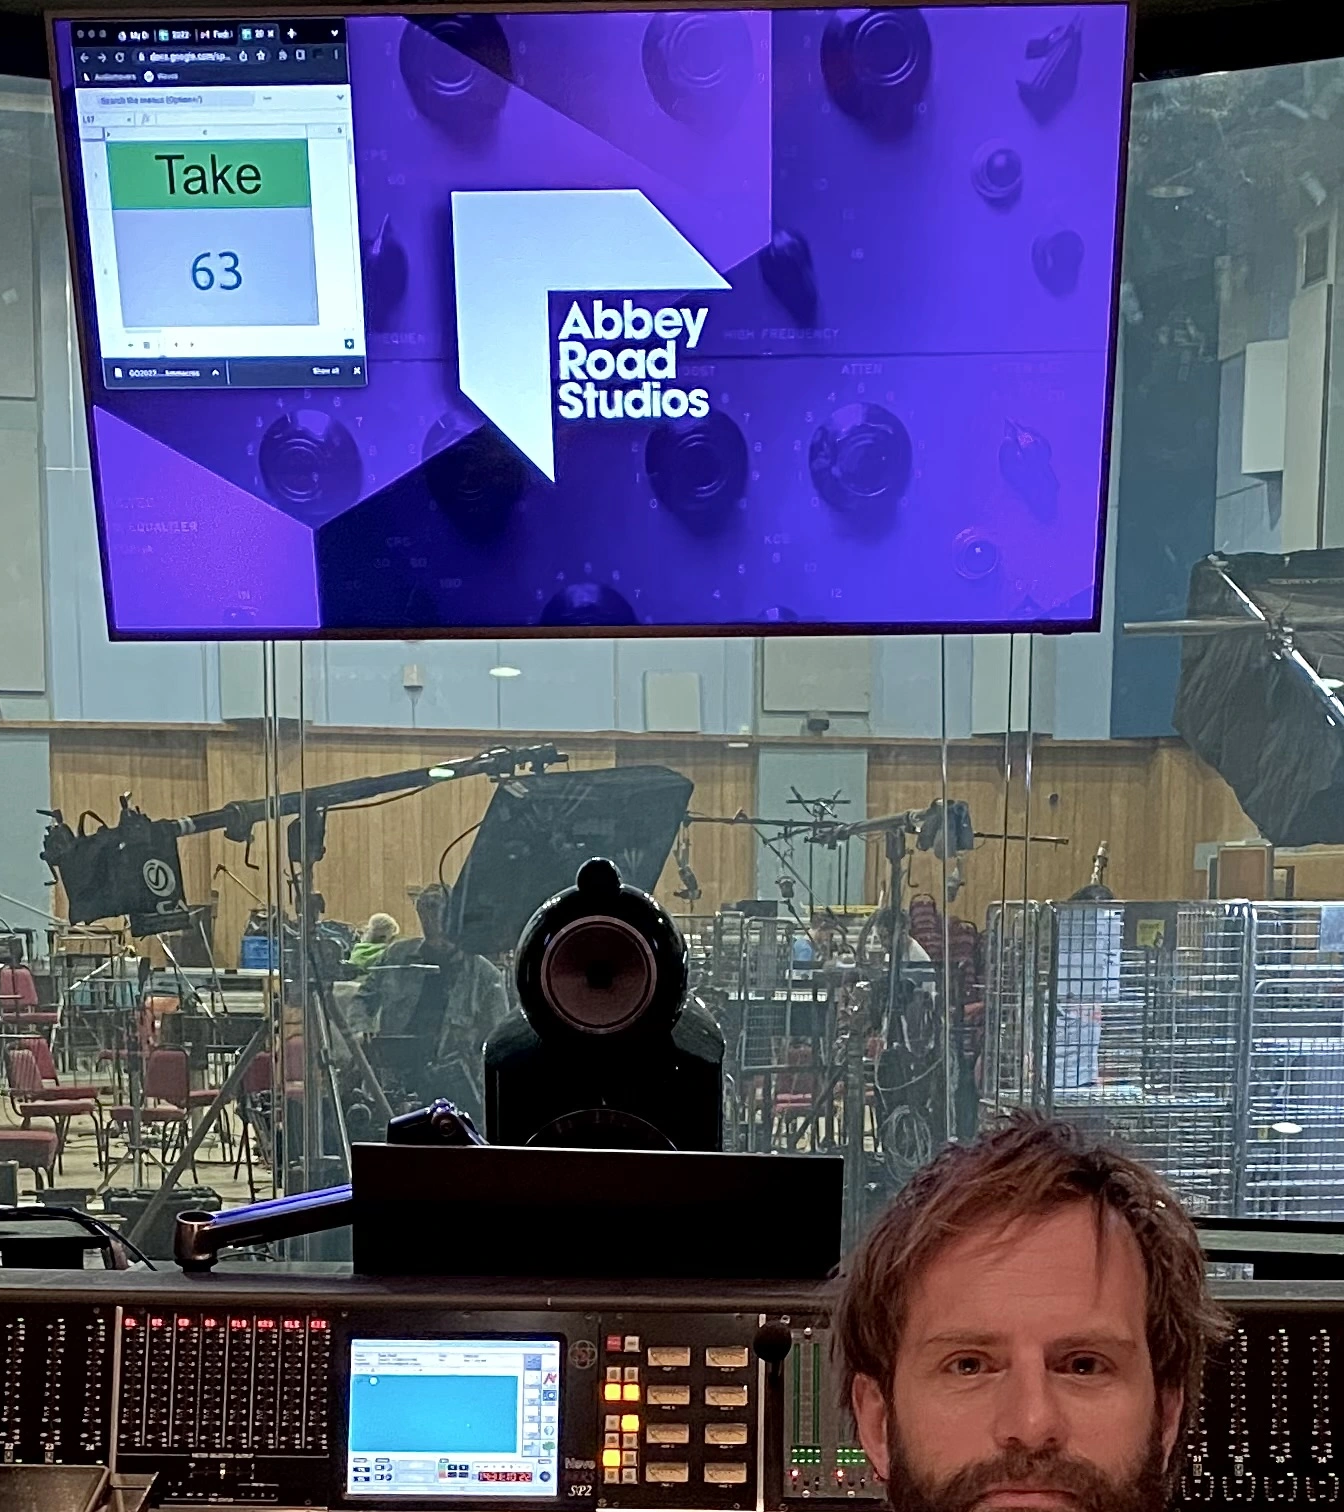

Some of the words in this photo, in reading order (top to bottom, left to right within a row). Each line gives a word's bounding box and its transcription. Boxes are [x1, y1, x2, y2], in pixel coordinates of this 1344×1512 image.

[155, 153, 262, 196] Take
[191, 251, 243, 292] 63
[557, 299, 709, 347] Abbey
[558, 340, 677, 381] Road
[558, 381, 710, 420] Studios
[567, 1484, 593, 1497] SP2
